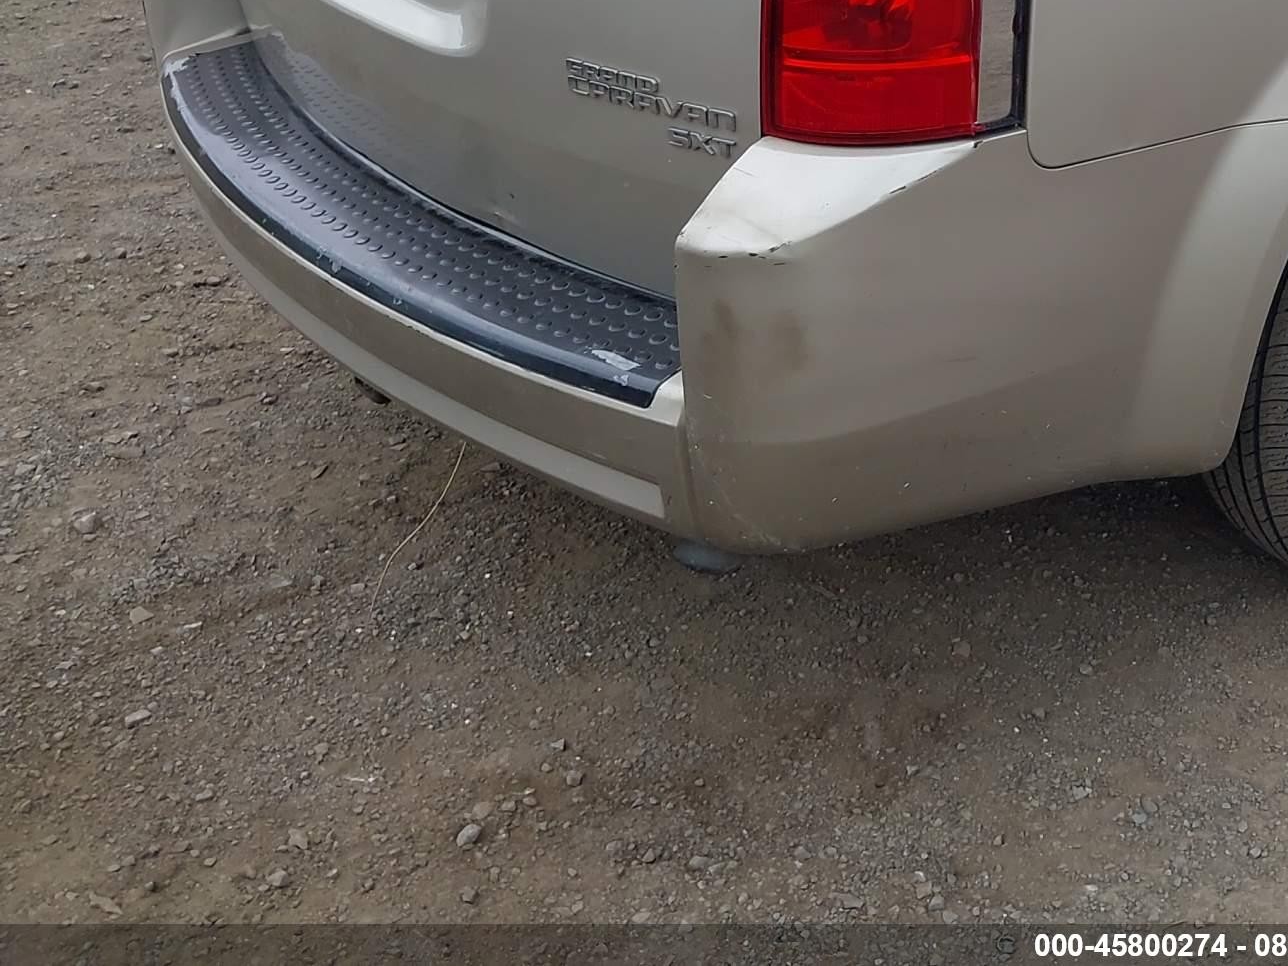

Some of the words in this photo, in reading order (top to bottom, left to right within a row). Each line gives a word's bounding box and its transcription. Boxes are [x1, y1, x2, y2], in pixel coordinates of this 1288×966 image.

[566, 57, 660, 93] GRAND
[567, 74, 737, 132] CARAVAN
[668, 126, 737, 158] SXT
